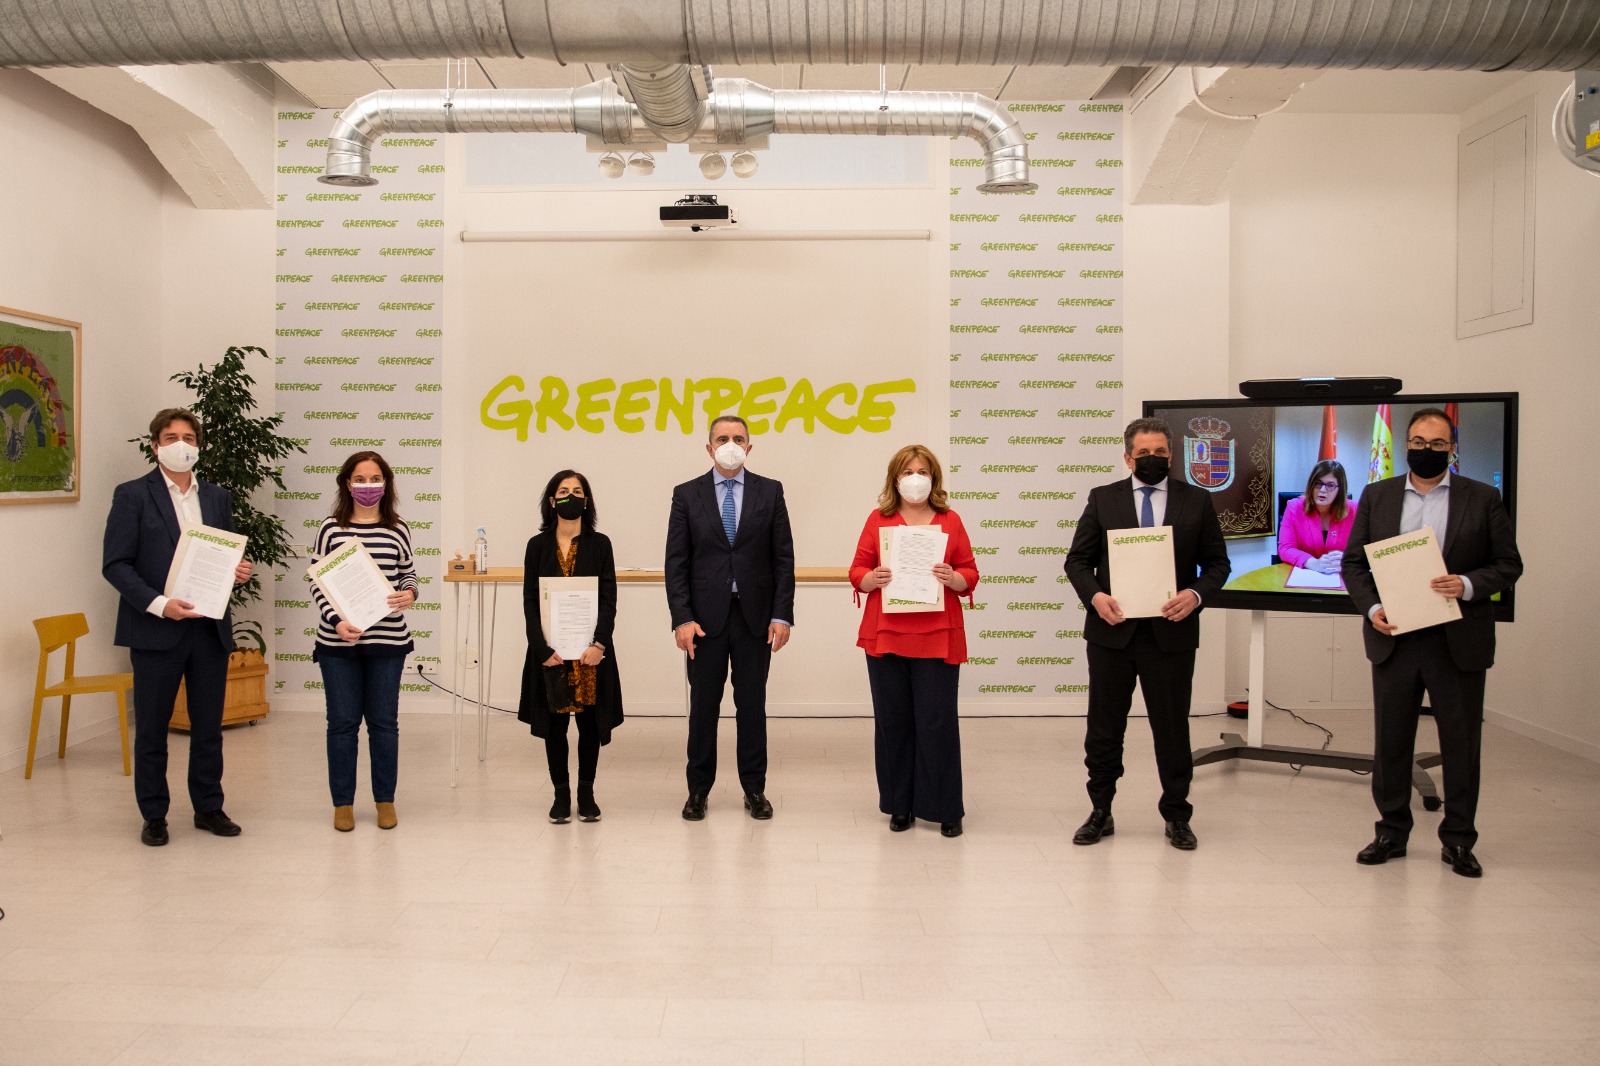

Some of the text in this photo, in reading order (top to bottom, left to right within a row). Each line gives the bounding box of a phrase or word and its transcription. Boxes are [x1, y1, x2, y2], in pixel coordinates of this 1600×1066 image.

[1008, 104, 1064, 112] GREENPEACE
[1057, 132, 1114, 141] GREENPEACE
[381, 138, 436, 147] GREENPEACE
[1056, 187, 1114, 196] GREENPEACE
[305, 192, 361, 202] GREENPEACE
[380, 192, 435, 201] GREENPEACE
[1019, 213, 1076, 223] GREENPEACE
[343, 219, 398, 228] GREENPEACE
[305, 247, 359, 256] GREENPEACE
[379, 247, 433, 256] GREENPEACE
[982, 242, 1038, 252] GREENPEACE
[1057, 242, 1115, 252] GREENPEACE
[331, 273, 386, 283] GREENPEACE
[1008, 269, 1066, 278] GREENPEACE
[379, 302, 432, 310] GREENPEACE
[982, 297, 1037, 306] GREENPEACE
[1058, 297, 1114, 307] GREENPEACE
[304, 303, 358, 311] GREENPEACE
[342, 327, 397, 336] GREENPEACE
[1020, 324, 1076, 333] GREENPEACE
[304, 357, 358, 365] GREENPEACE
[378, 357, 432, 366] GREENPEACE
[981, 353, 1037, 362] GREENPEACE
[1057, 353, 1114, 362] GREENPEACE
[341, 383, 396, 391] GREENPEACE
[1019, 380, 1075, 389] GREENPEACE
[480, 375, 916, 442] GREENPEACE
[982, 409, 1036, 417] GREENPEACE
[304, 411, 358, 420] GREENPEACE
[378, 412, 432, 421] GREENPEACE
[331, 438, 384, 446] GREENPEACE
[1008, 436, 1065, 445] GREENPEACE
[980, 465, 1037, 473] GREENPEACE
[1057, 464, 1114, 473] GREENPEACE
[1019, 491, 1075, 500] GREENPEACE
[981, 519, 1036, 528] GREENPEACE
[187, 530, 240, 549] GREENPEACE
[1113, 534, 1167, 545] GREENPEACE
[1373, 536, 1429, 559] GREENPEACE
[317, 544, 358, 578] GREENPEACE
[981, 576, 1036, 584] GREENPEACE
[1008, 602, 1064, 611] GREENPEACE
[979, 631, 1036, 639] GREENPEACE
[1017, 657, 1074, 666] GREENPEACE
[979, 685, 1035, 693] GREENPEACE
